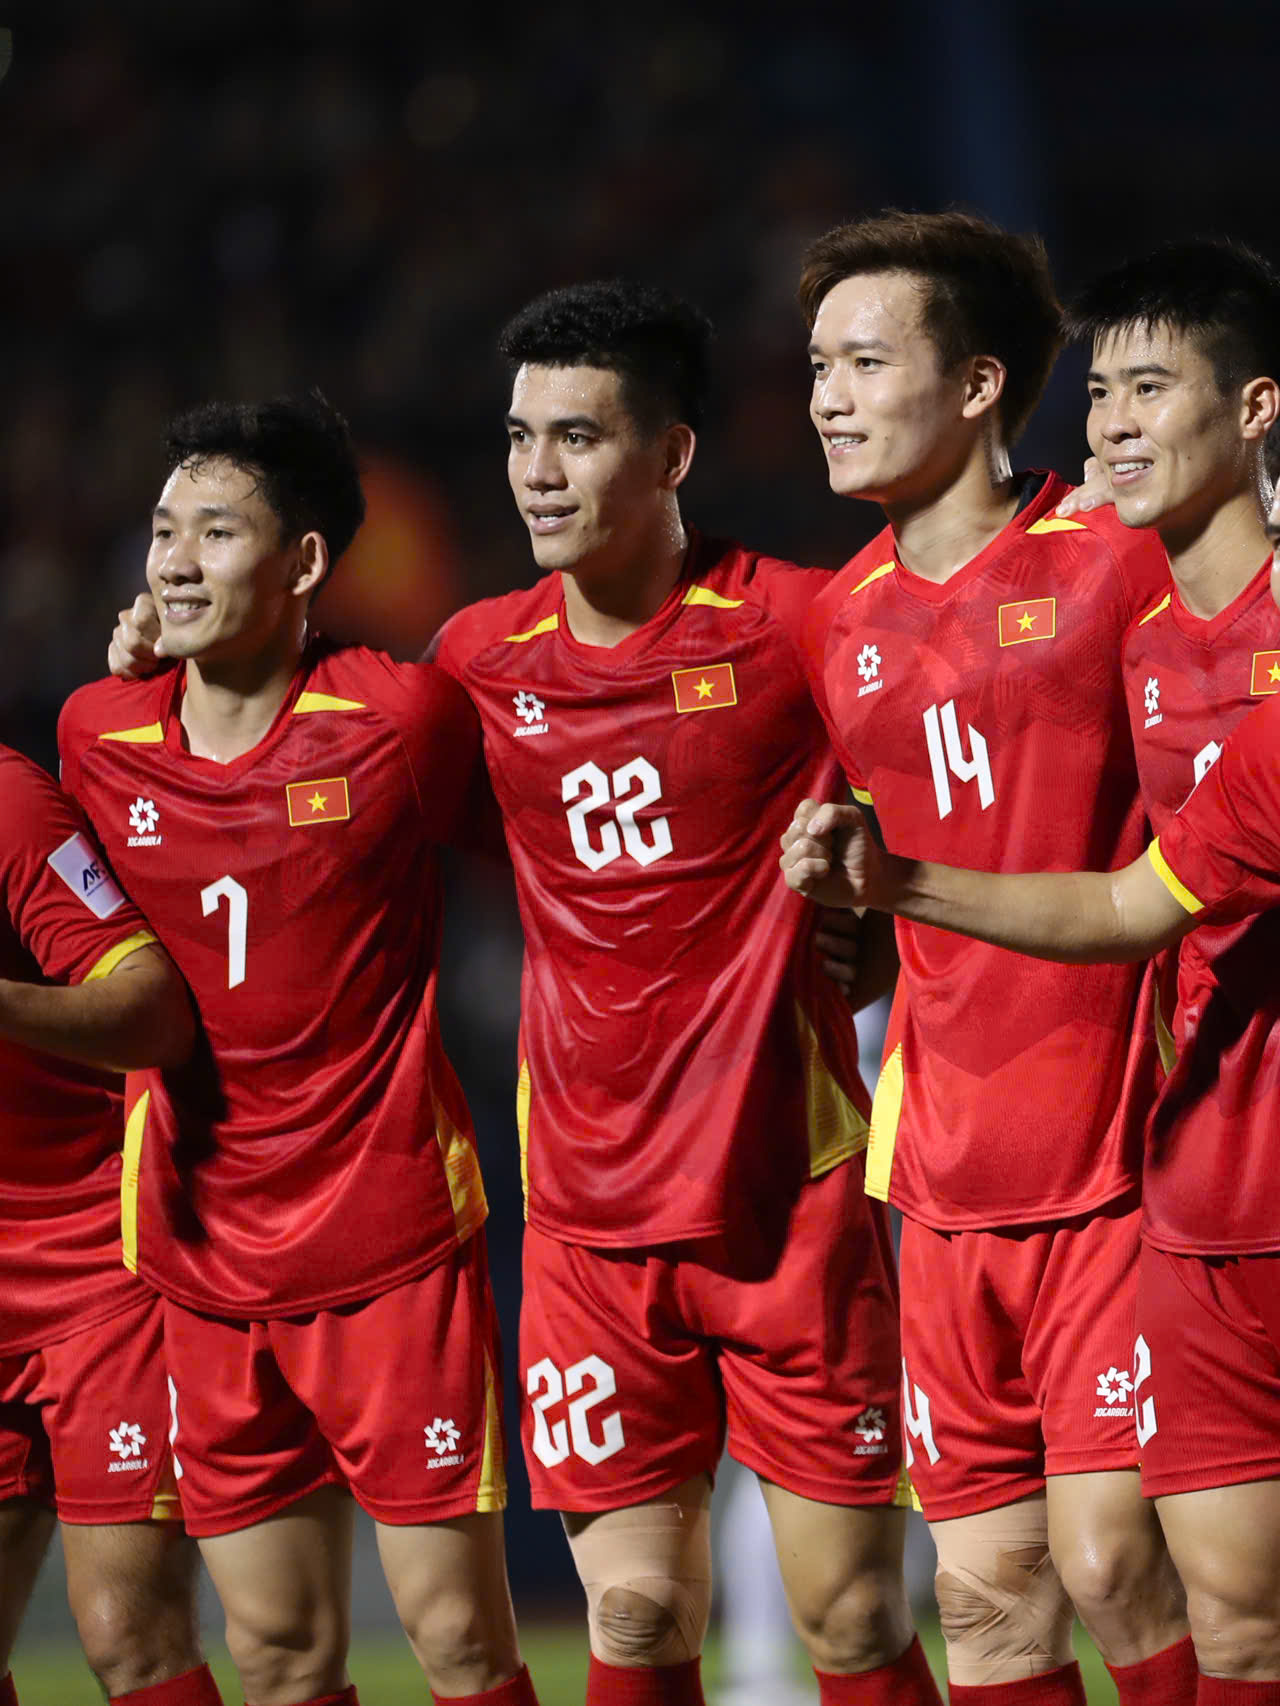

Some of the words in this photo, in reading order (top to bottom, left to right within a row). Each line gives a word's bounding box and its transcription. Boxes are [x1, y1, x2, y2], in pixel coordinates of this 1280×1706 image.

[561, 756, 674, 873] 22
[922, 698, 995, 820] 14
[200, 874, 248, 990] 7
[526, 1354, 625, 1469] 22
